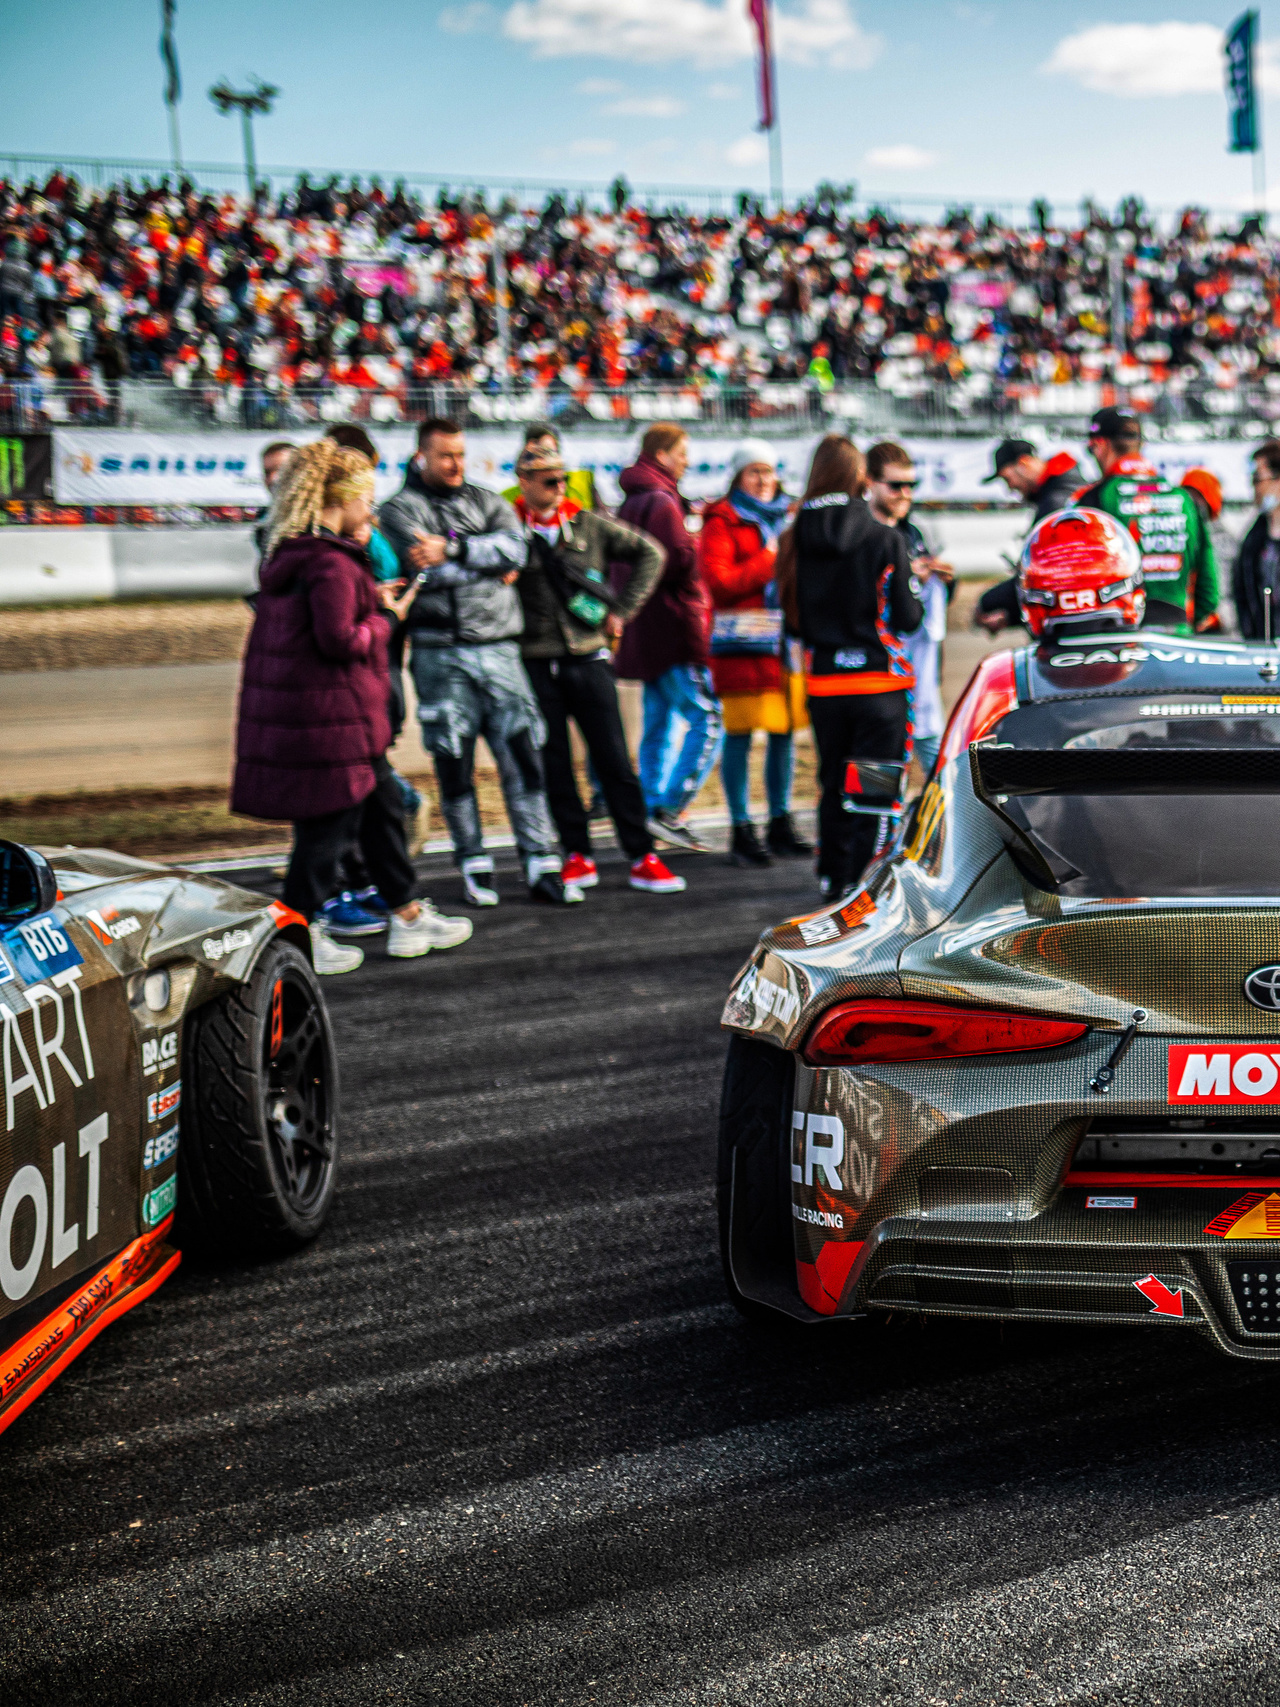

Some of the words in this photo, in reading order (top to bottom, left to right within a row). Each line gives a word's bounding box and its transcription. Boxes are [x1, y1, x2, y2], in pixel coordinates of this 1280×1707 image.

[1059, 589, 1096, 610] CR
[1049, 647, 1280, 668] CARVILLE
[807, 1209, 844, 1229] RACING
